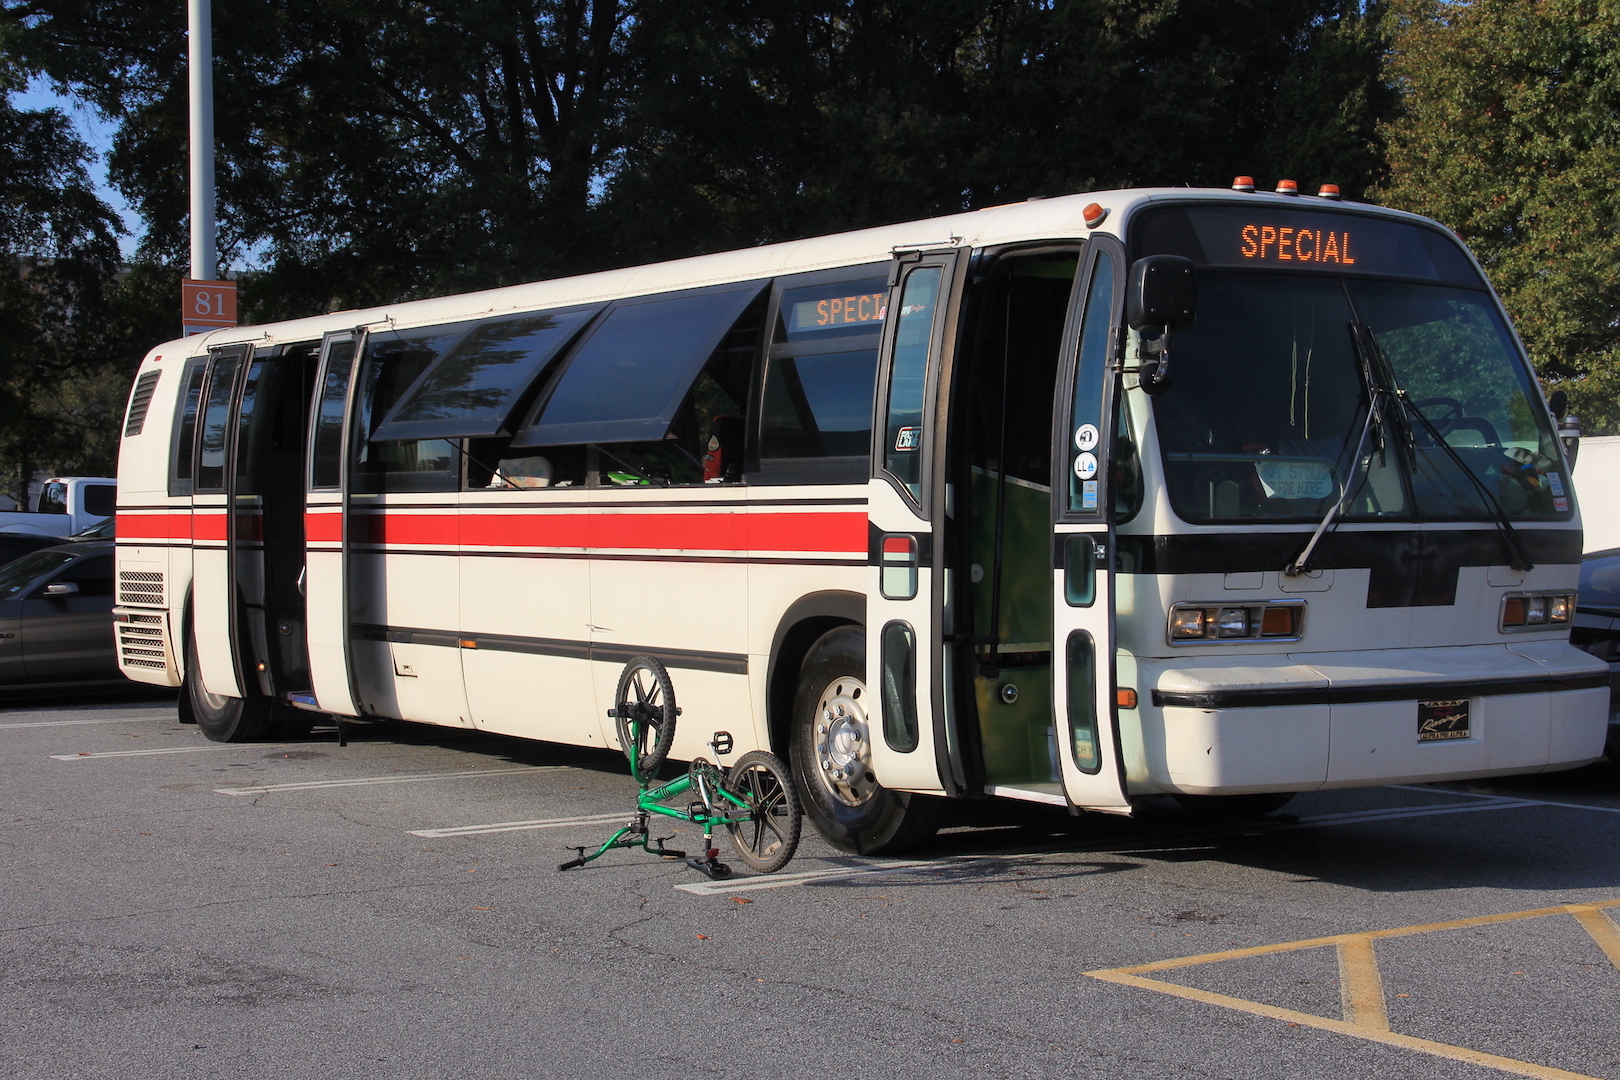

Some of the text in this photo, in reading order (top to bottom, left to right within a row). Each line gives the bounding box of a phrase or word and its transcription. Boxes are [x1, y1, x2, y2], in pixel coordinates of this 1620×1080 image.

[1241, 224, 1355, 264] SPECIAL
[195, 291, 226, 316] 81
[1278, 481, 1295, 496] FOR
